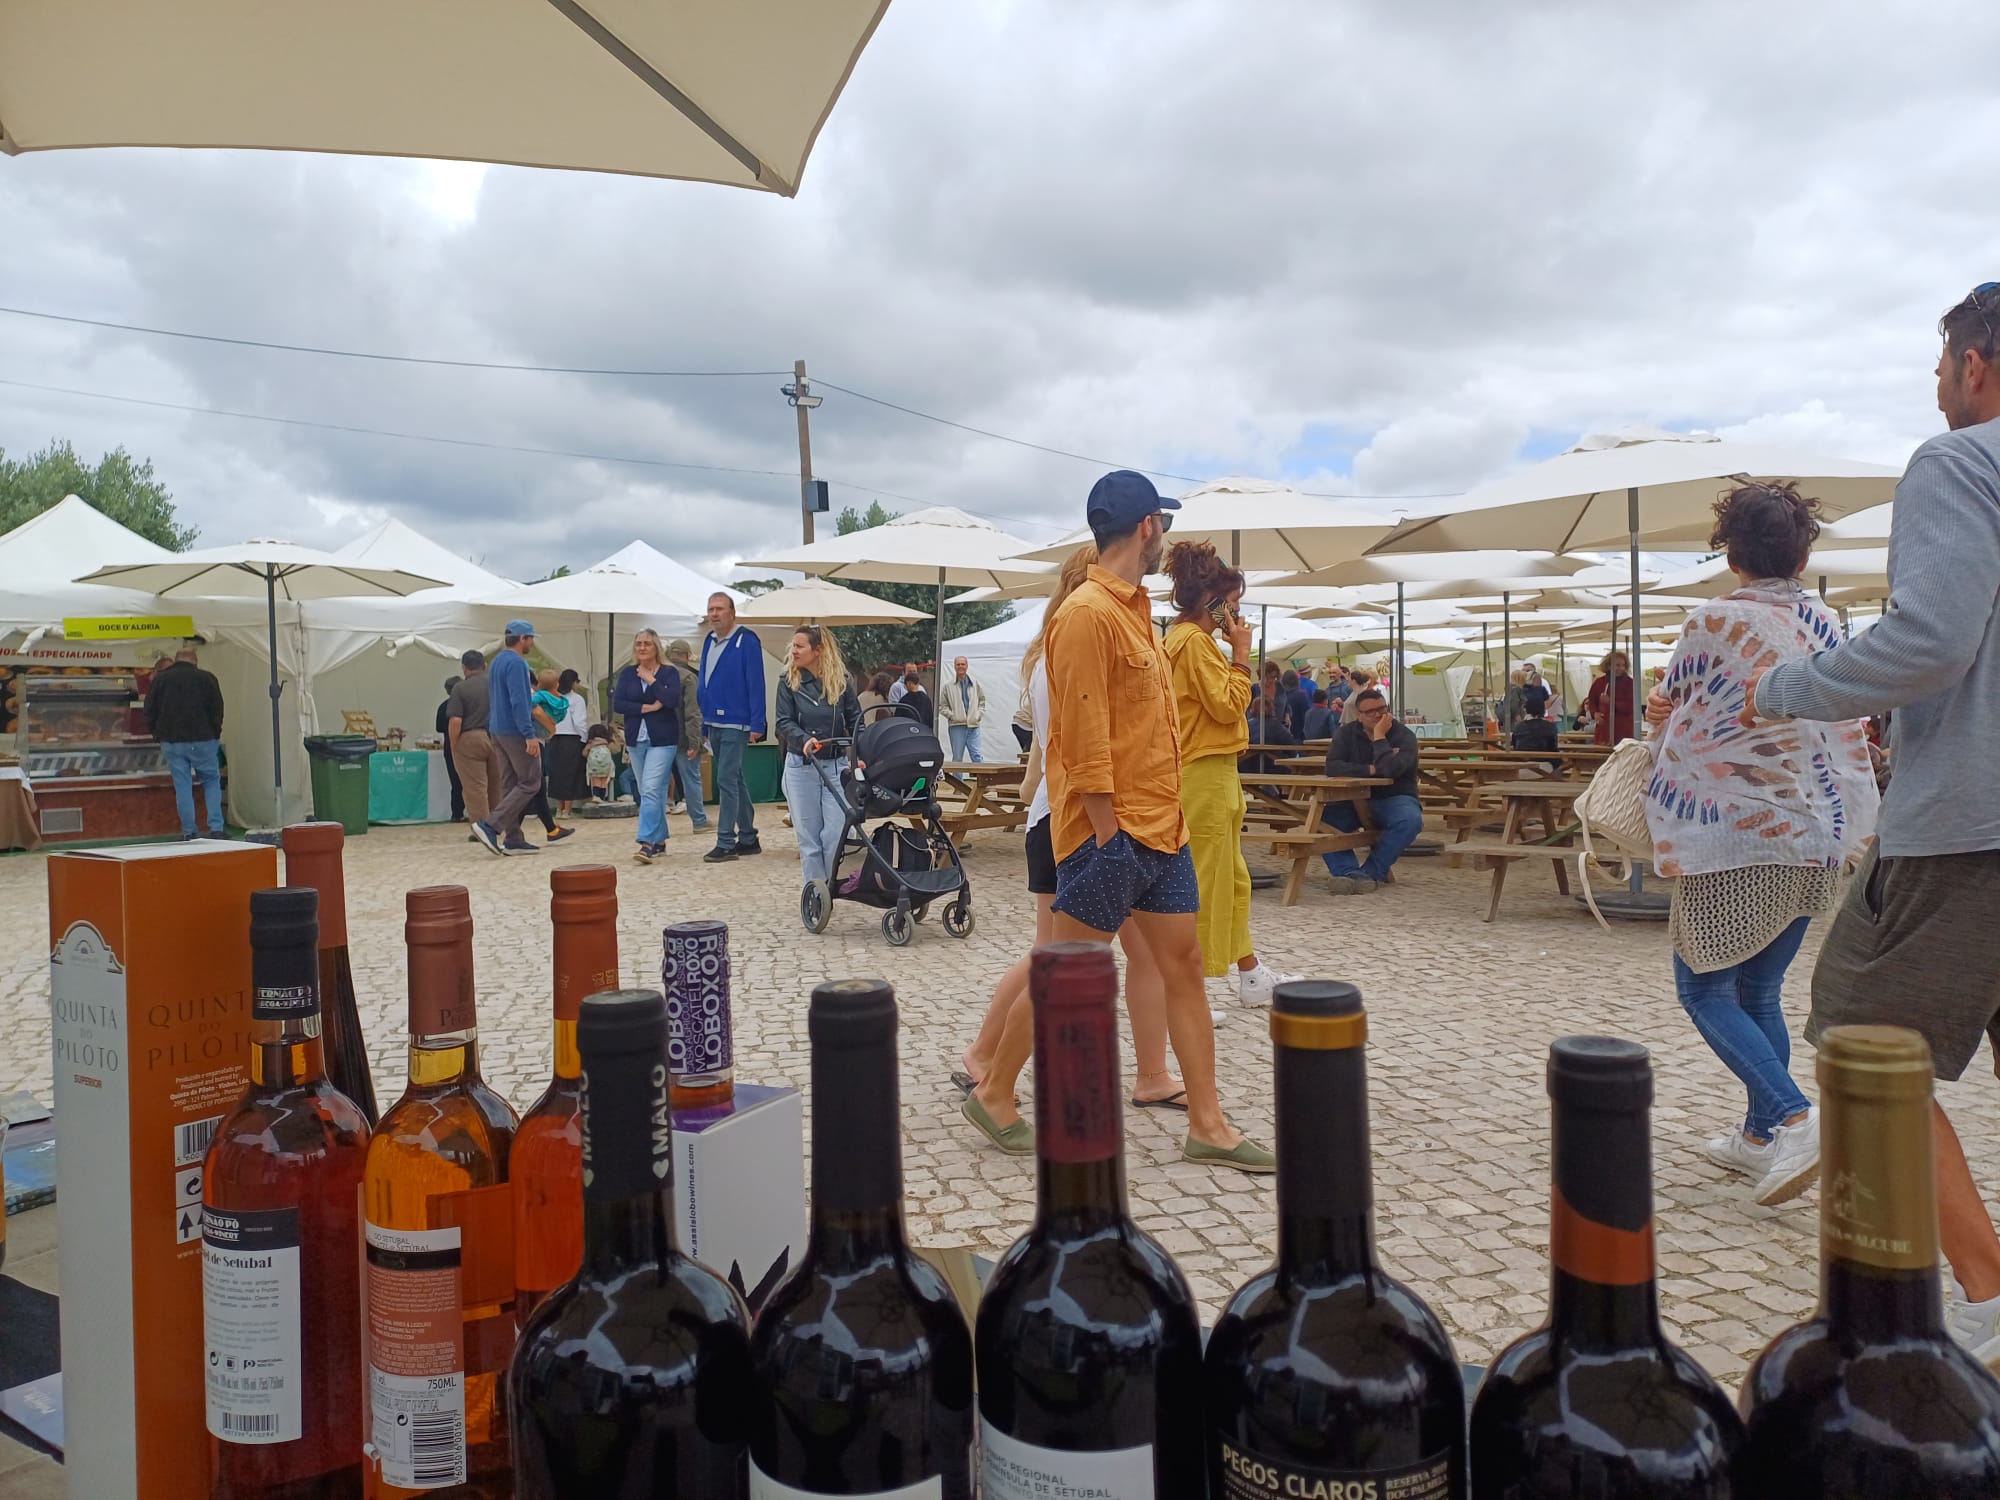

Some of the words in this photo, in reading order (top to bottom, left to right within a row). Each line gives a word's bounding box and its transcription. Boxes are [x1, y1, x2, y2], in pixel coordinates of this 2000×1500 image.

[98, 624, 120, 632] DOCE
[32, 651, 113, 660] ESPECIALIDADE
[684, 937, 702, 984] ROXO
[56, 998, 118, 1030] QUINTA
[148, 991, 247, 1030] QUINT
[56, 1038, 119, 1072] PILOTO
[652, 1064, 669, 1156] MALO
[688, 1143, 698, 1260] w.assislobowines.com
[211, 1253, 222, 1265] de
[223, 1256, 273, 1269] Setúbal
[428, 1377, 457, 1390] 750ML
[455, 1411, 463, 1443] 001617
[455, 1445, 463, 1477] 603016
[1010, 1461, 1067, 1486] REGIONAL
[1222, 1443, 1280, 1490] PEGOS
[1285, 1472, 1378, 1500] CLAROS
[1034, 1482, 1050, 1494] DE
[1055, 1486, 1112, 1499] SETÚBAL
[1386, 1471, 1430, 1490] RESERVA
